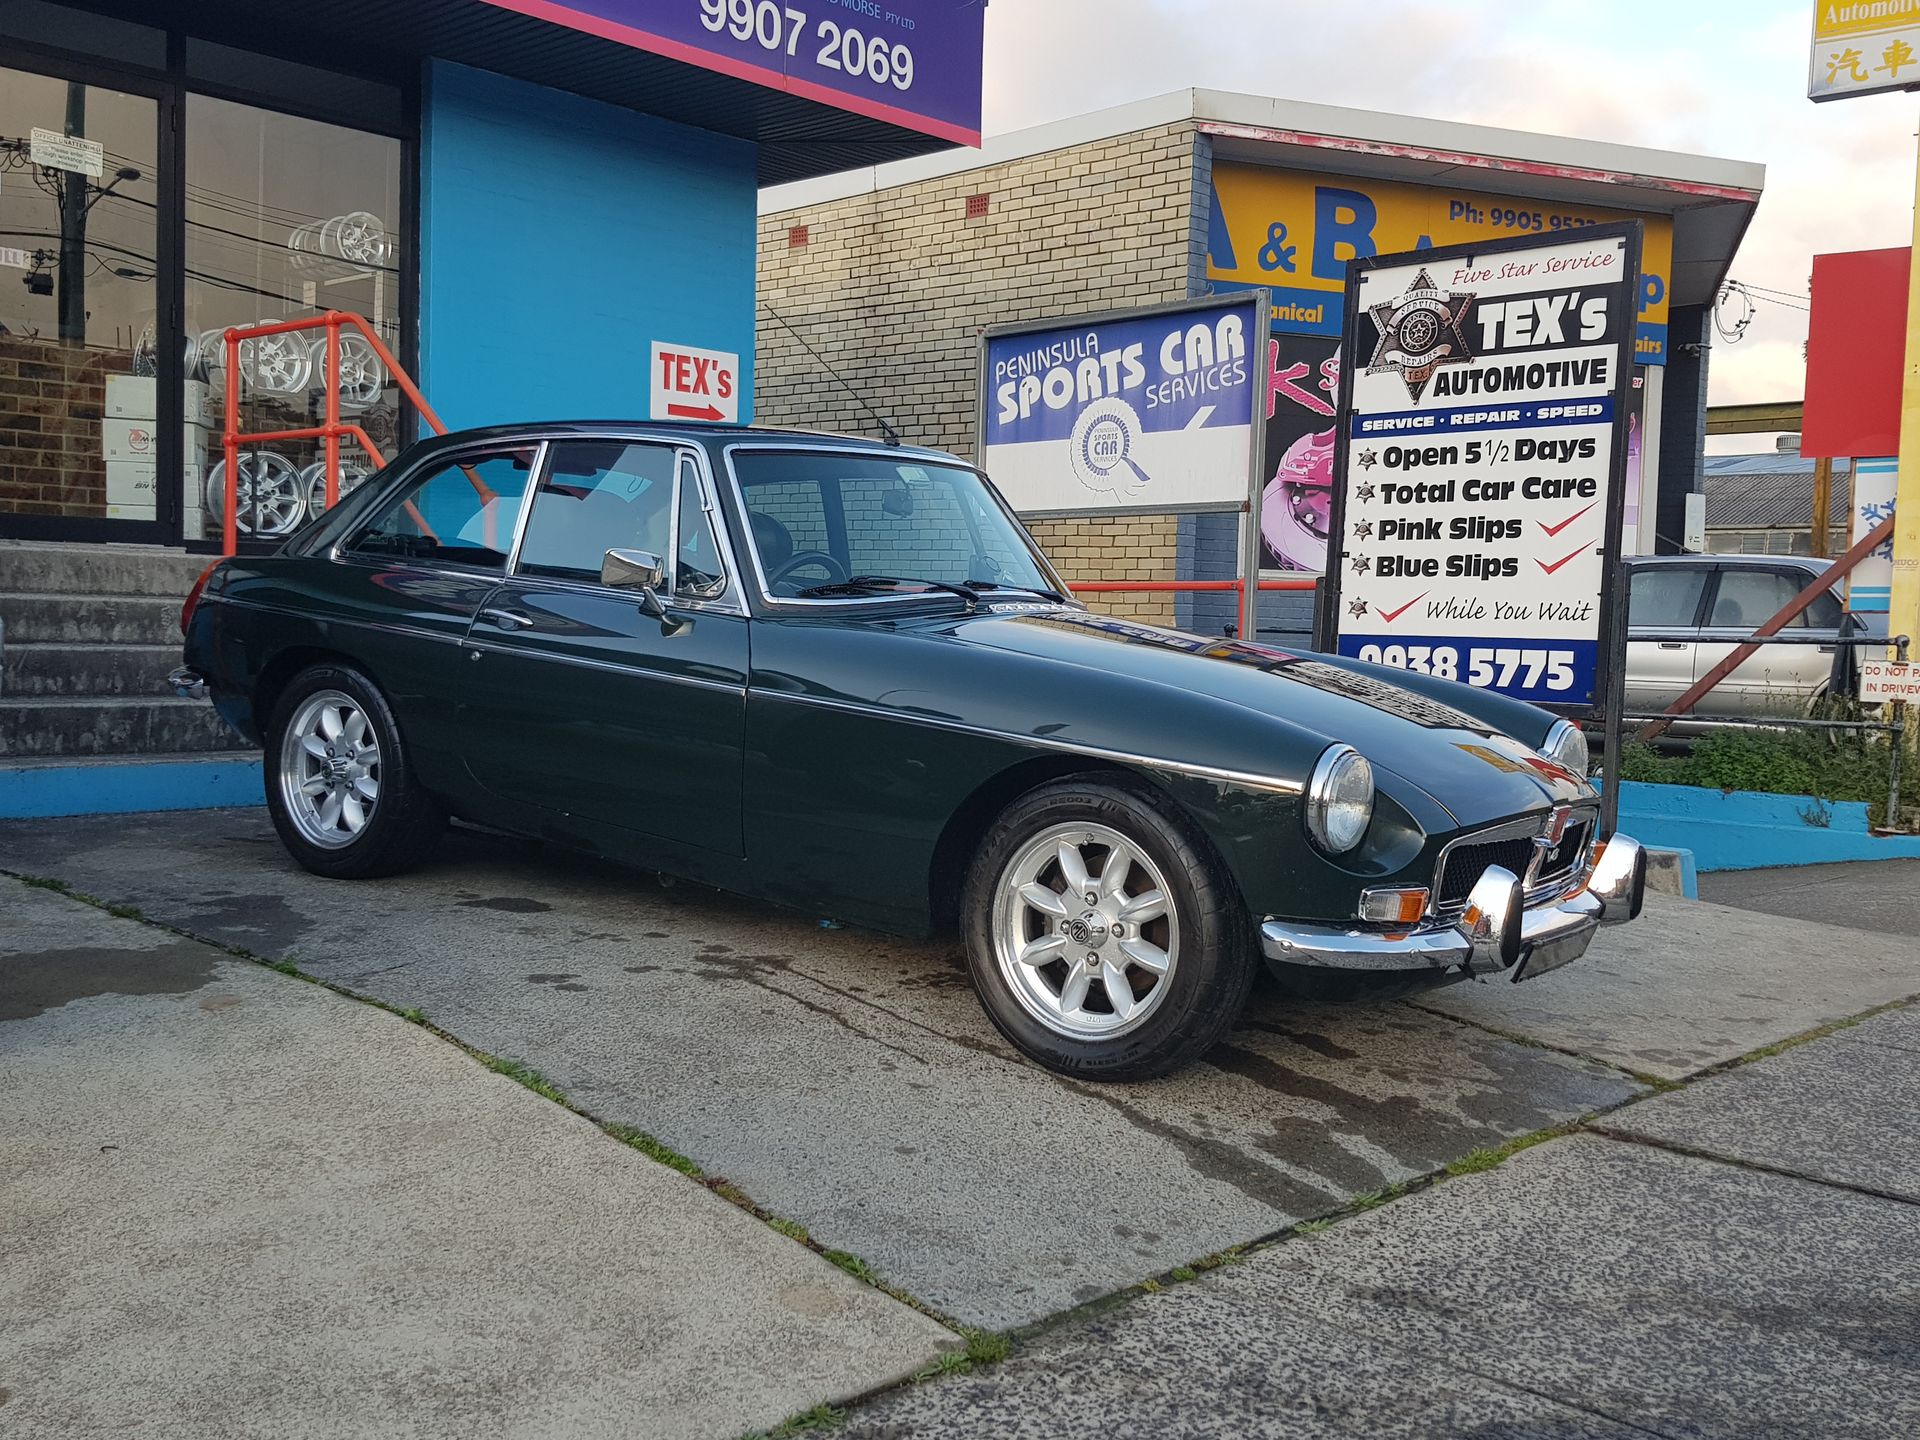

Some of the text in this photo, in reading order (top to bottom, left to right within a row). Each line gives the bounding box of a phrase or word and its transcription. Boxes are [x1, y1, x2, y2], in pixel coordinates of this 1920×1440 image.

[885, 11, 900, 25] PTY
[901, 19, 915, 30] LTD
[1823, 0, 1920, 25] Automoti
[700, 0, 914, 91] 9907 2069
[1825, 39, 1918, 86] 汽車
[34, 132, 57, 142] OFFICE
[1449, 200, 1484, 224] Ph:
[1490, 207, 1543, 231] 9905
[1258, 222, 1296, 273] &
[1311, 186, 1377, 281] B
[1452, 251, 1616, 286] Five Star Service
[1401, 301, 1440, 315] SERVICE
[1403, 291, 1438, 301] QUALITY
[995, 332, 1099, 384] PENINSULA
[997, 314, 1246, 425] SPORTS CAR
[1401, 349, 1437, 365] REPAIRS
[1146, 360, 1247, 409] SERVICES
[1433, 357, 1608, 397] AUTOMOTIVE
[1361, 404, 1603, 431] SERVICE REPAIR SPEED
[1094, 433, 1118, 441] SPORTS
[1094, 440, 1118, 456] CAR
[1383, 445, 1458, 471] Open
[1514, 438, 1596, 463] Days
[1381, 477, 1597, 504] Total Car Care
[1378, 516, 1522, 543] Pink Slips
[1375, 553, 1519, 581] Blue Slips
[1427, 596, 1594, 621] While You Wait
[1468, 648, 1575, 691] 5775
[1865, 666, 1881, 676] DO
[1885, 667, 1908, 677] NOT
[1866, 682, 1877, 692] IN
